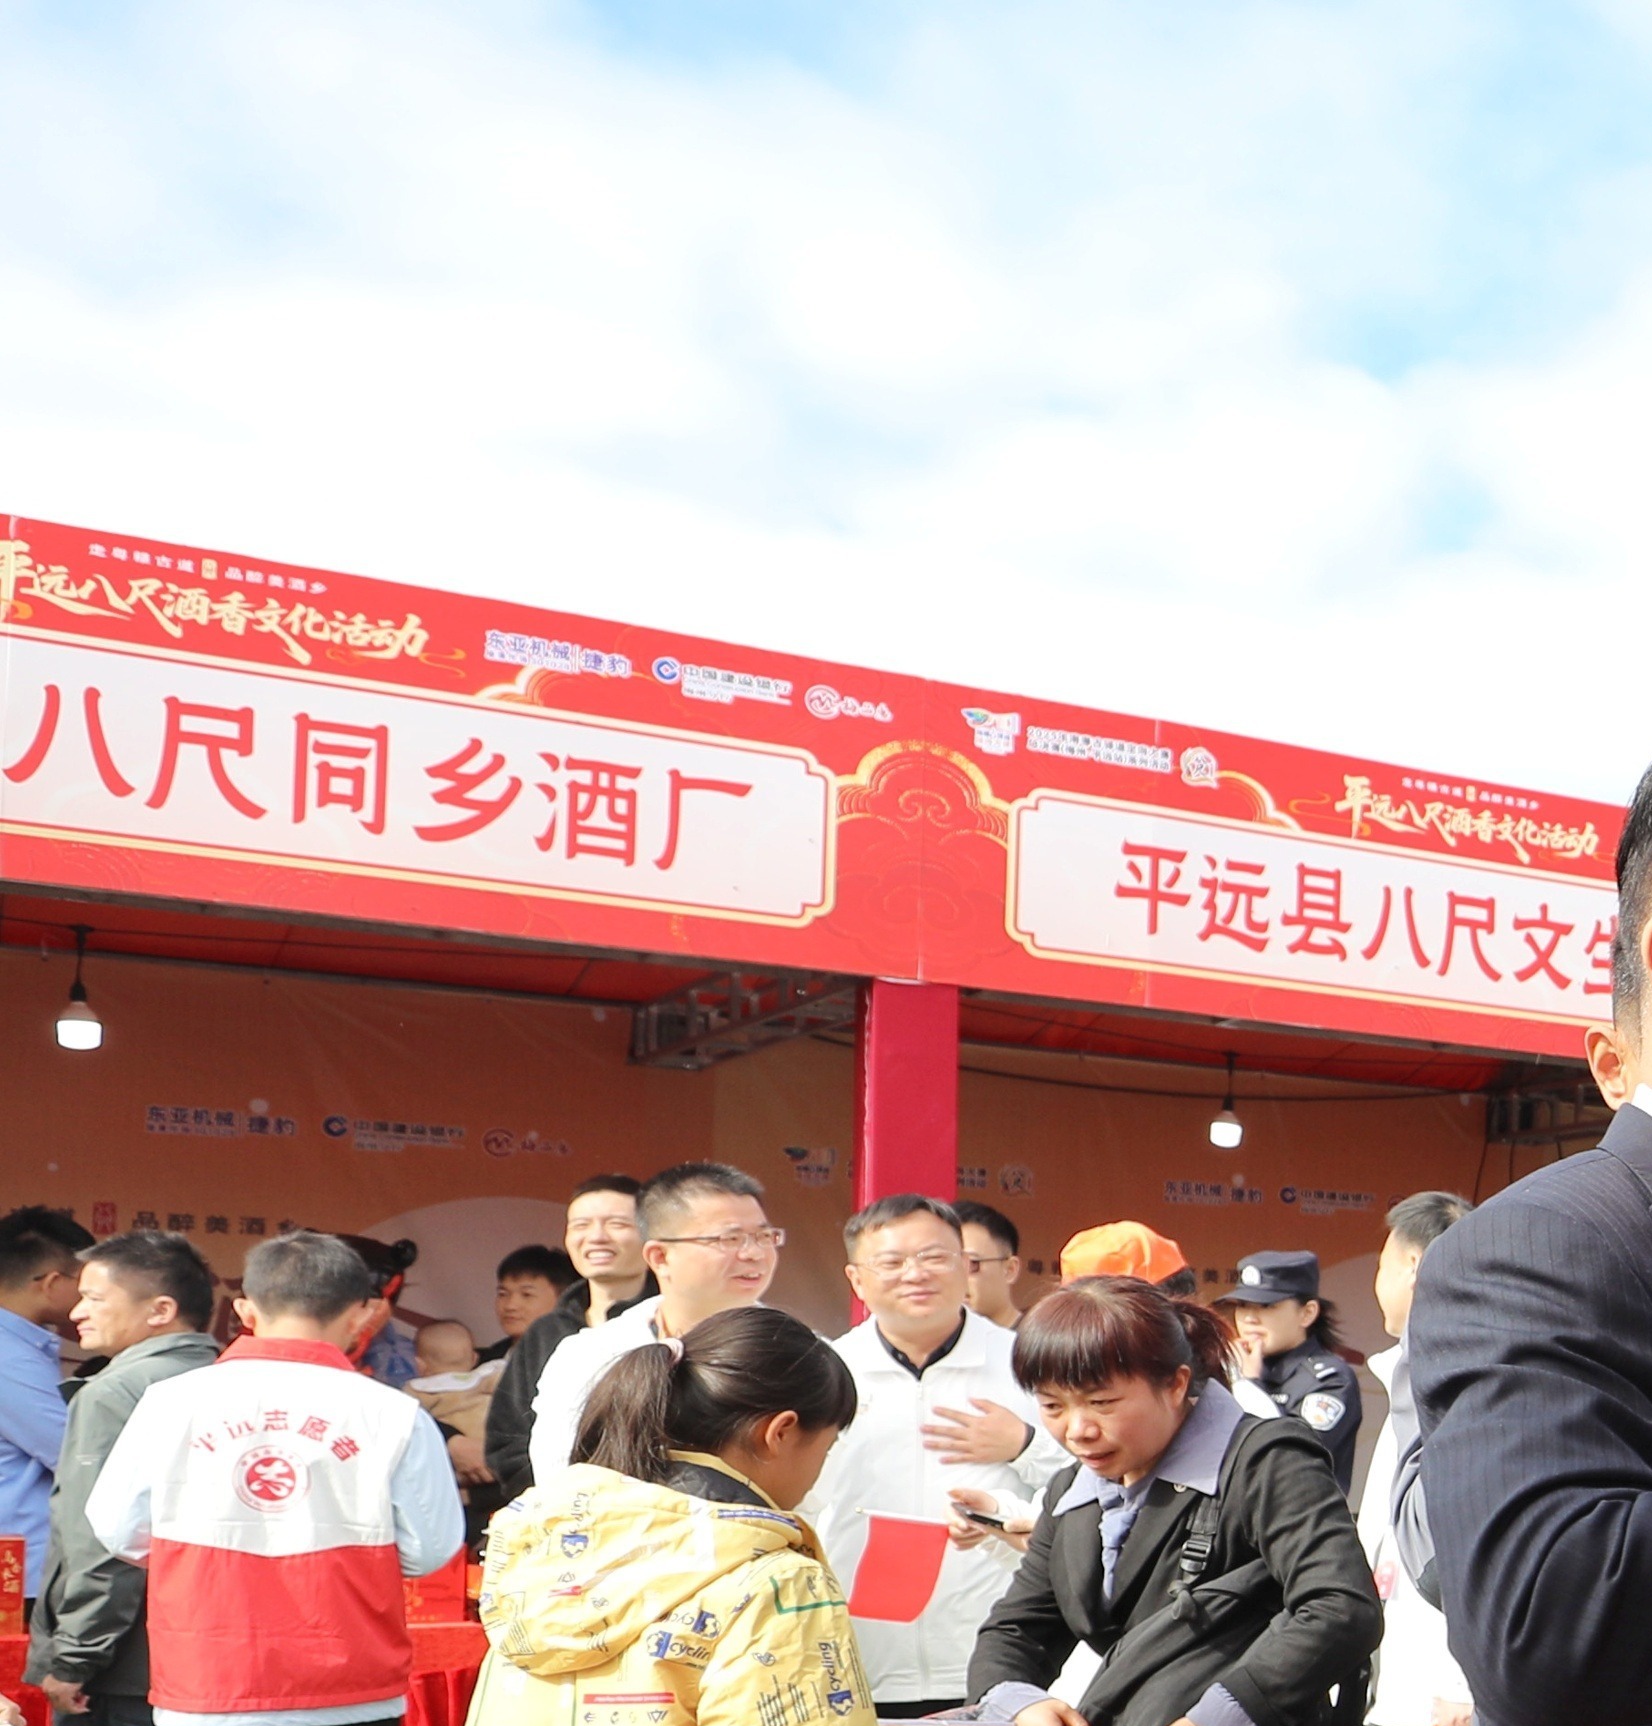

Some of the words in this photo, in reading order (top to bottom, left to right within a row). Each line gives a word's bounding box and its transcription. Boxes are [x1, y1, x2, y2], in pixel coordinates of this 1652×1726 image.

[487, 632, 571, 661] 东亚机械
[3, 684, 753, 871] 八尺同乡酒厂
[1335, 774, 1599, 865] 平远八尺酒香文化活动
